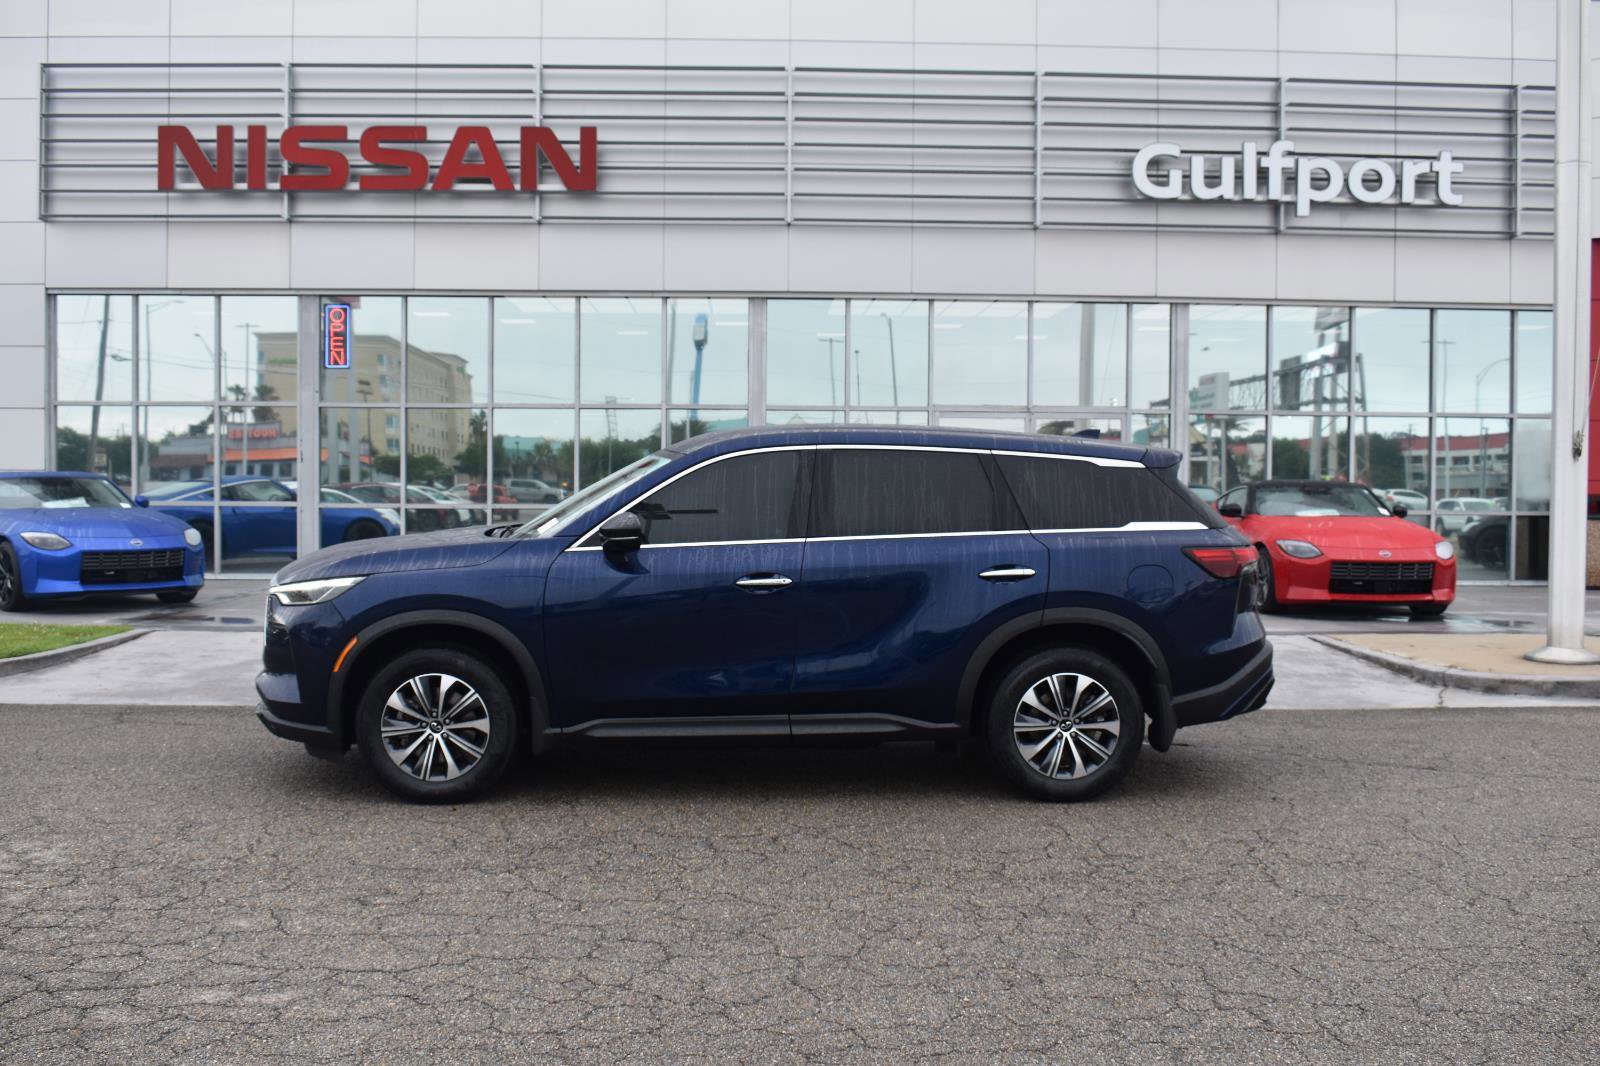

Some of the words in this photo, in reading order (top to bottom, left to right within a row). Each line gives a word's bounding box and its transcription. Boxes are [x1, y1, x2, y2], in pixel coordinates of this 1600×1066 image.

[158, 125, 597, 191] NISSAN
[1132, 140, 1464, 216] Gulfport
[329, 308, 346, 365] OPEN
